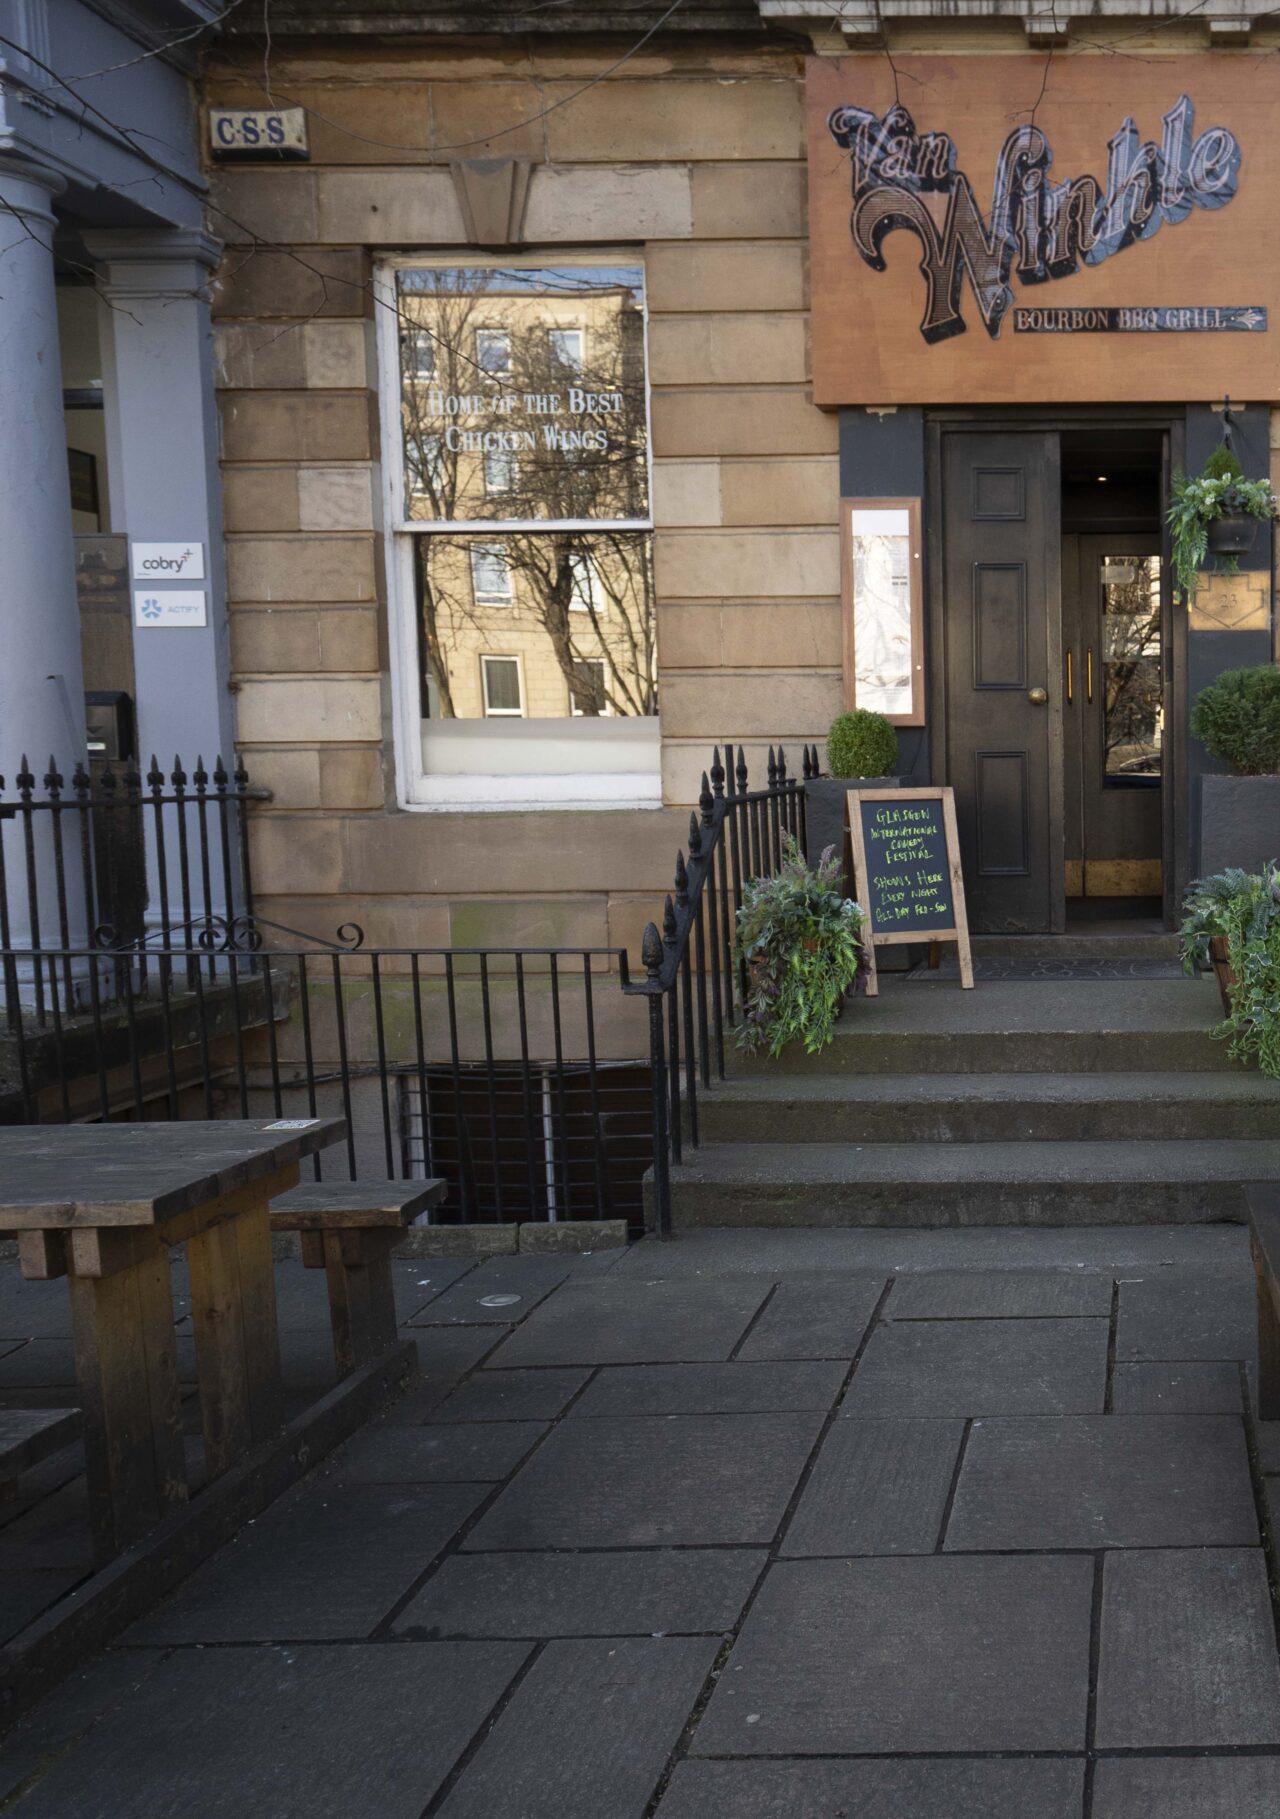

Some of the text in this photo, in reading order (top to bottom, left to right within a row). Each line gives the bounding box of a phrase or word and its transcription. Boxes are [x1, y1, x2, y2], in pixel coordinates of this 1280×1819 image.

[827, 105, 957, 192] Van
[852, 94, 1242, 344] Winkle
[1017, 308, 1227, 330] BOURBON BBQ GRILL
[428, 390, 485, 416] HOME
[523, 393, 561, 414] THE
[568, 388, 624, 414] BEST
[445, 424, 608, 452] CHICKEN WINGS
[142, 555, 184, 573] cobry
[876, 808, 930, 826] GLASGOW
[885, 849, 934, 864] FESTIVAL
[916, 870, 944, 886] HERE
